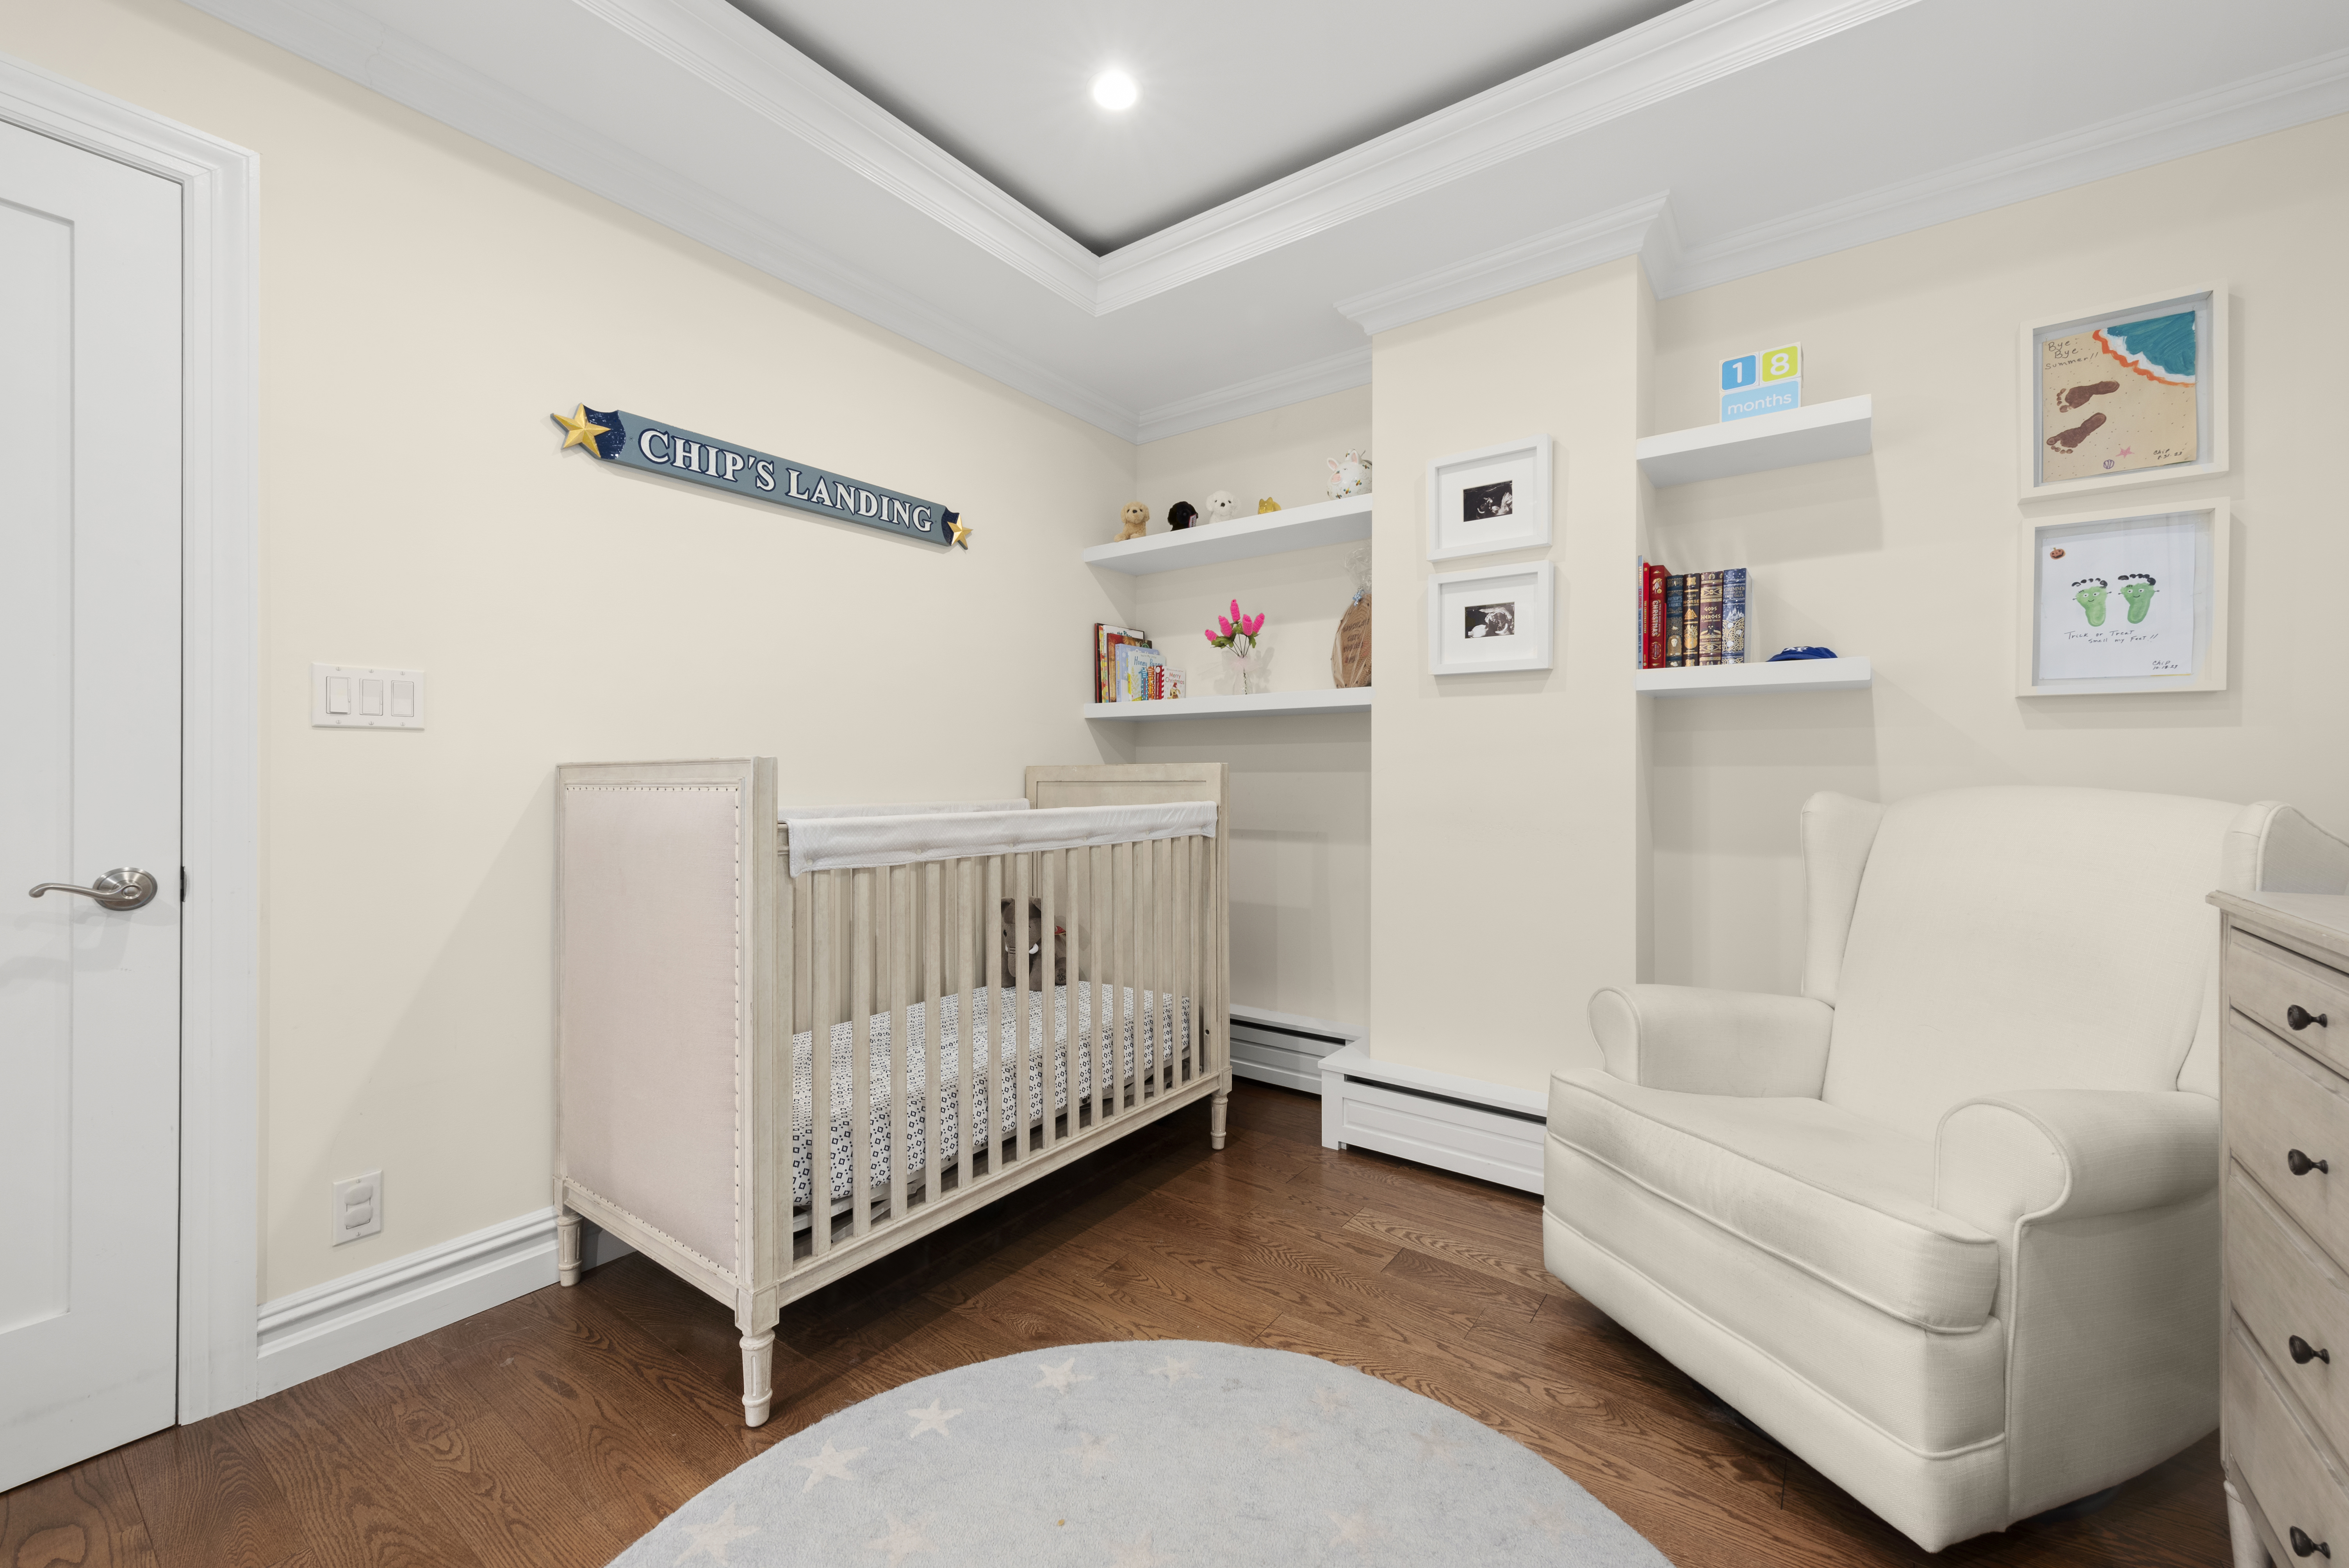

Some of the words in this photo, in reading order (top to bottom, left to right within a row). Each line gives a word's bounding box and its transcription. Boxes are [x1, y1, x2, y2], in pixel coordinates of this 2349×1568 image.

[1728, 394, 1791, 415] months
[638, 428, 775, 492] CHIP'S
[785, 467, 933, 533] LANDING
[2064, 631, 2088, 640] Trick
[1134, 656, 1147, 667] Honey
